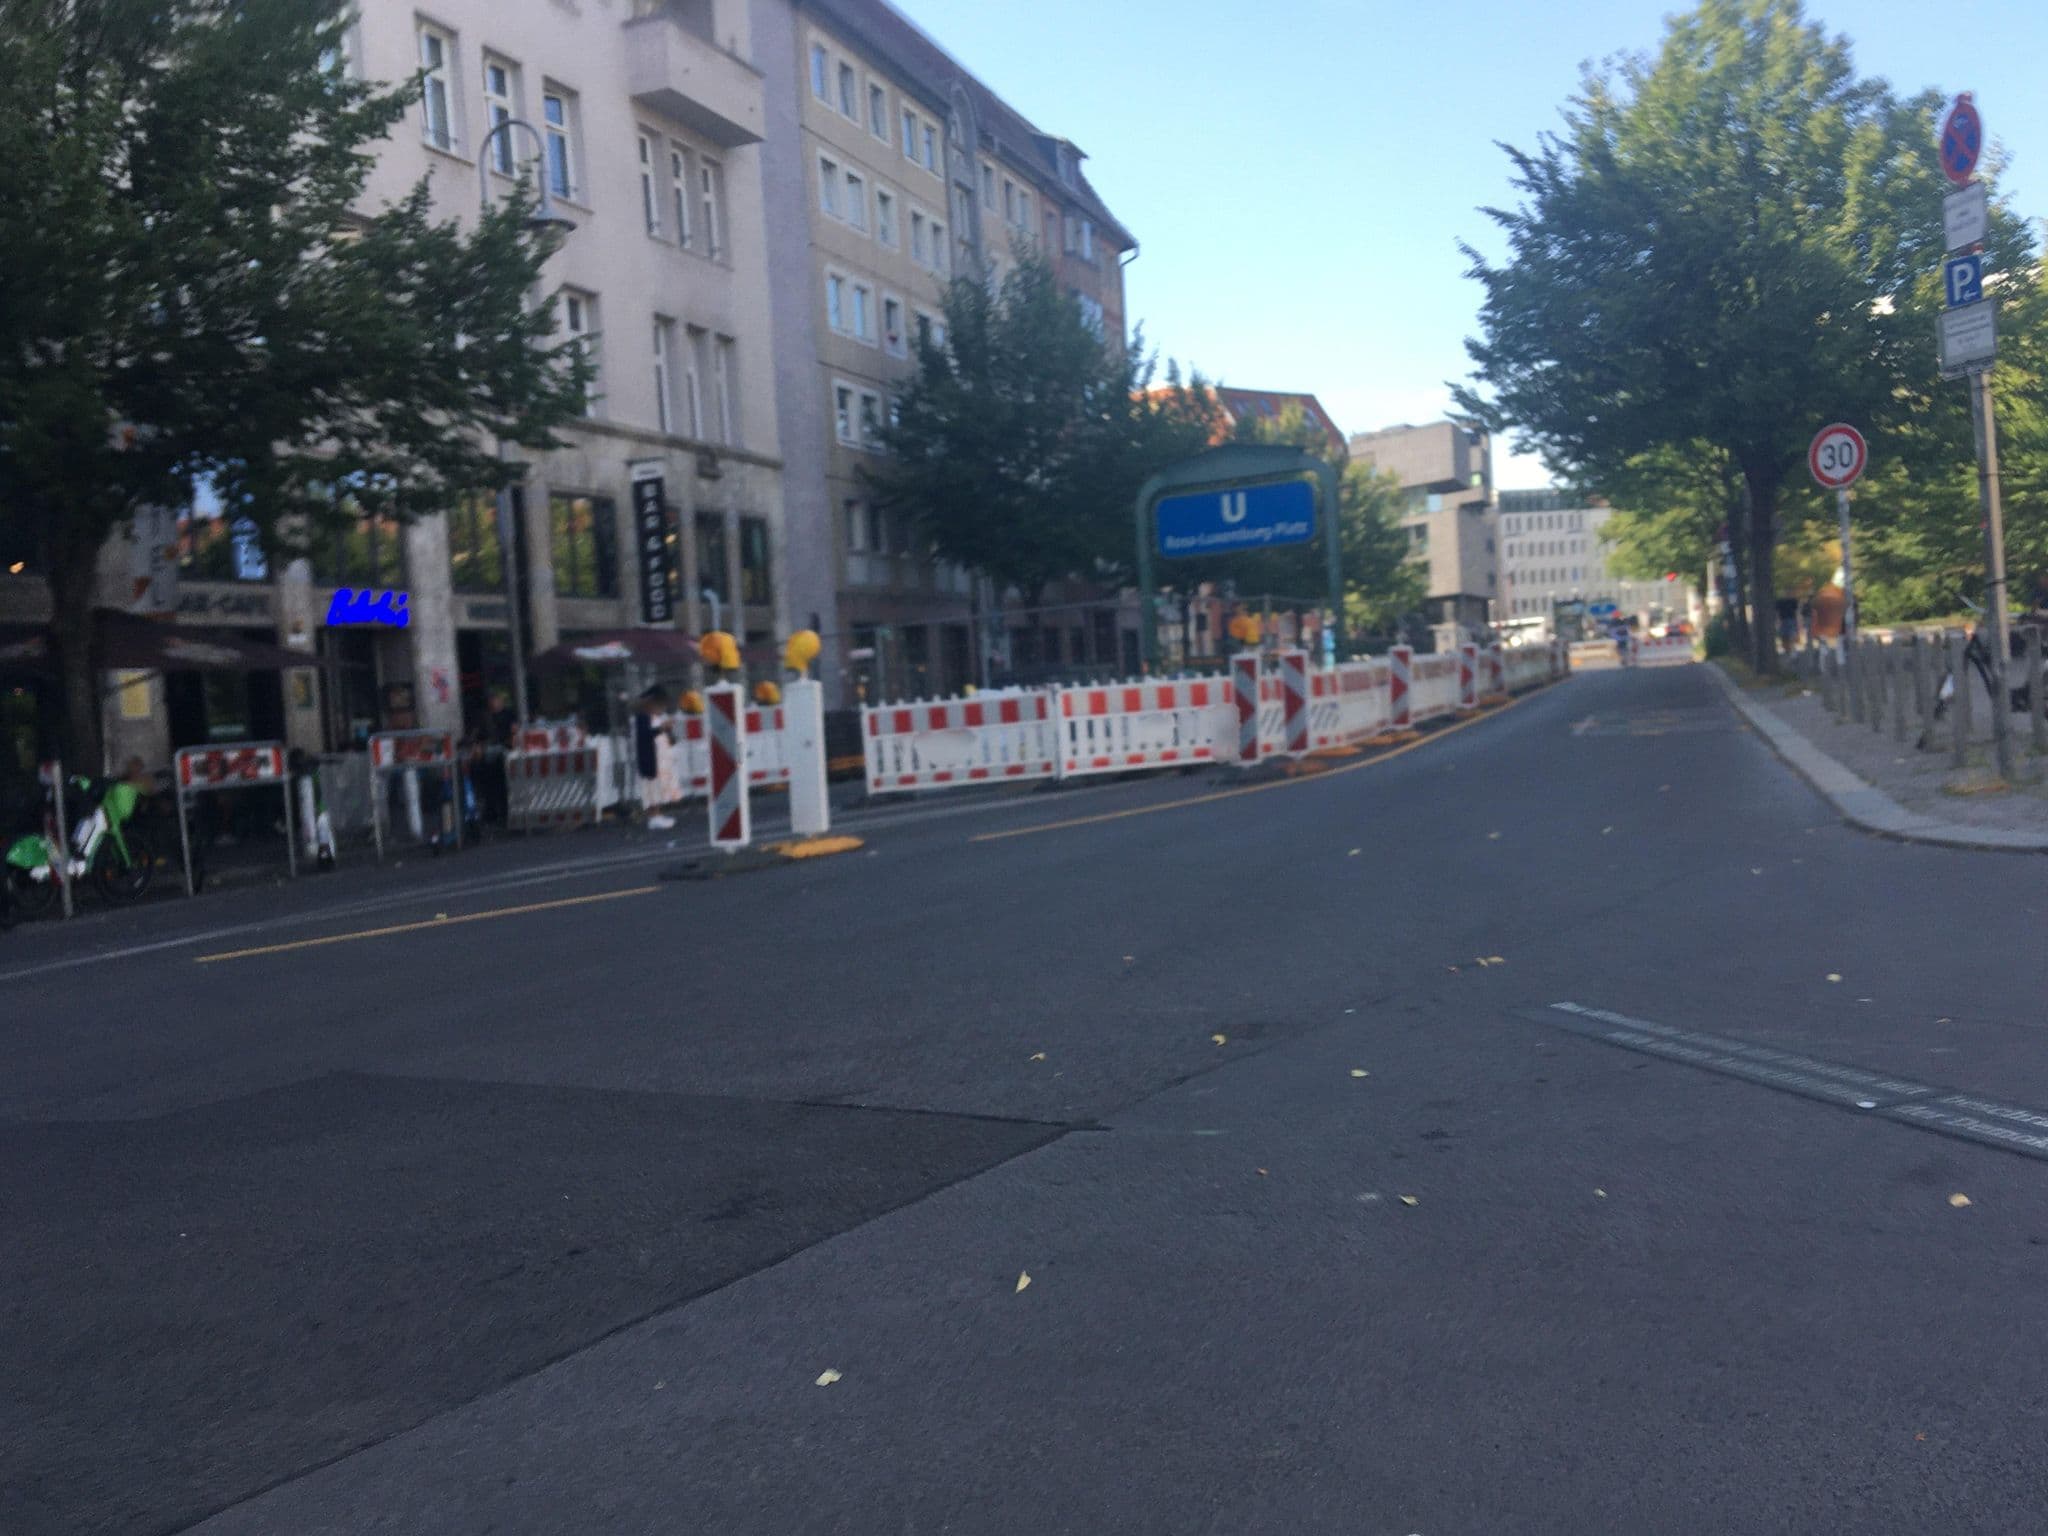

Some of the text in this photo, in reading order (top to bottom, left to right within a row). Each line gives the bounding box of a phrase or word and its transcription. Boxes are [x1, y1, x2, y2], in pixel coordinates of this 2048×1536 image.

[1952, 262, 1973, 301] P
[1822, 441, 1853, 470] 30
[1221, 491, 1247, 524] U
